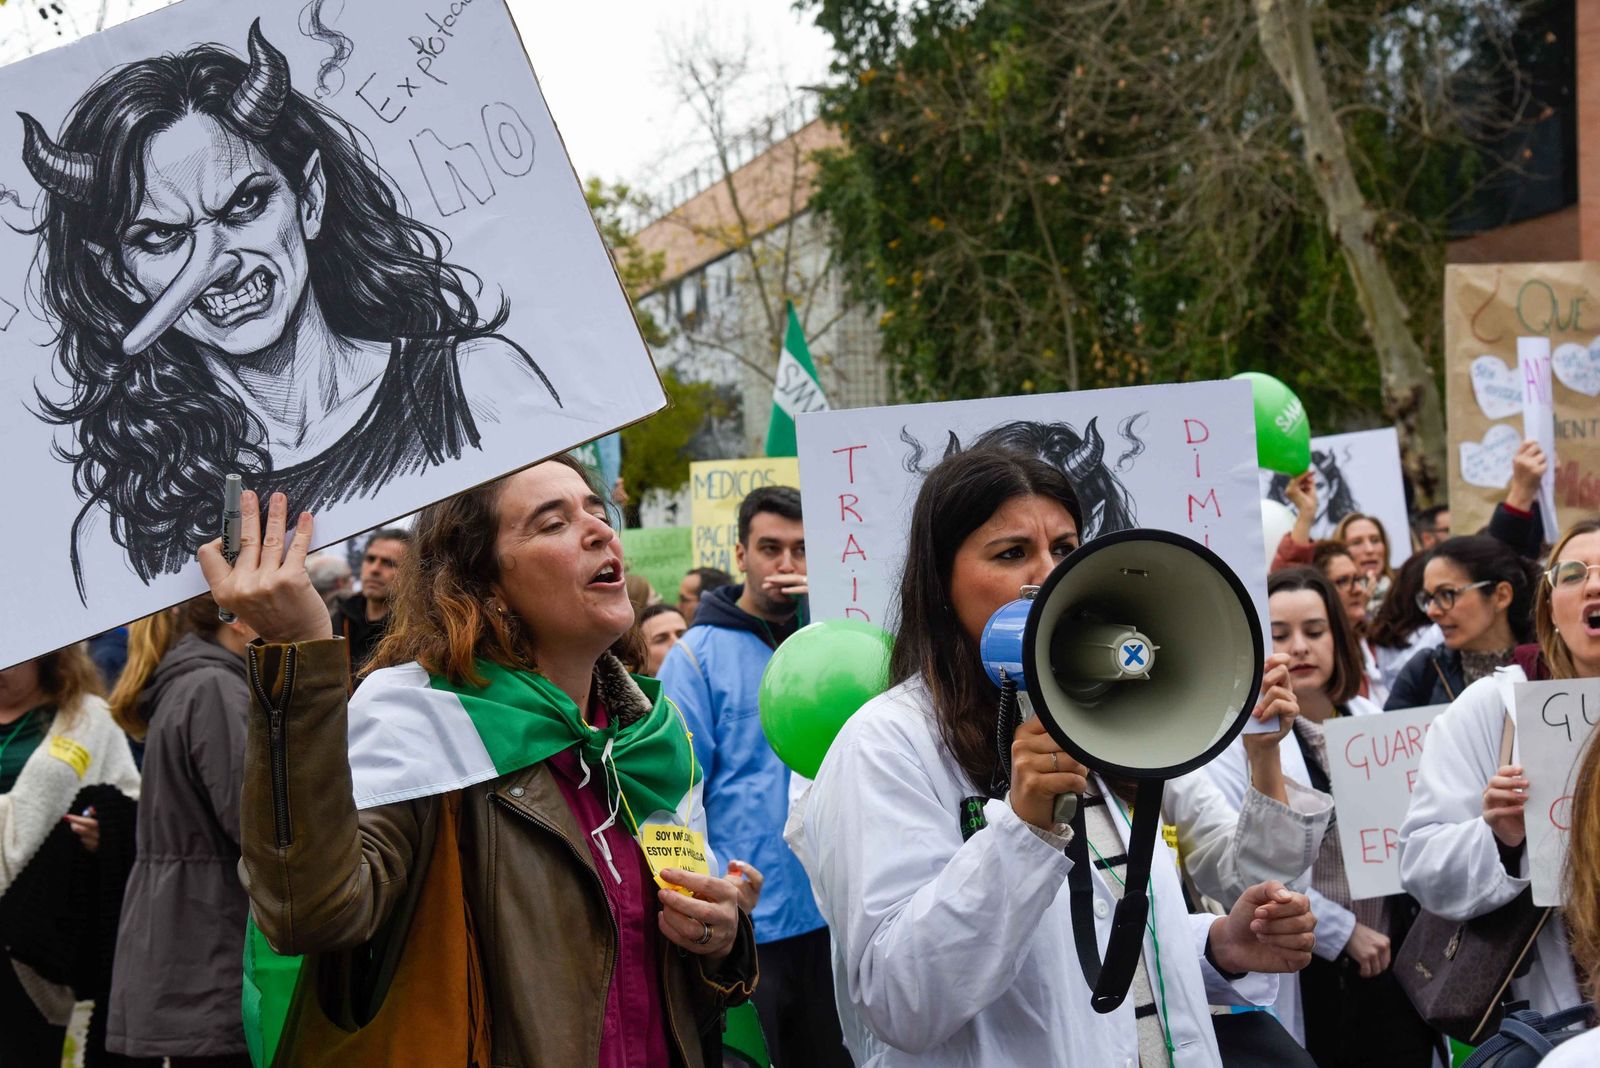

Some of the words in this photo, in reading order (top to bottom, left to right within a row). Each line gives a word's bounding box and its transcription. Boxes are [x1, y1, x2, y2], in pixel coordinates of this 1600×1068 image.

[408, 101, 536, 217] NO
[656, 831, 671, 841] SOY
[647, 847, 672, 856] ESTOY
